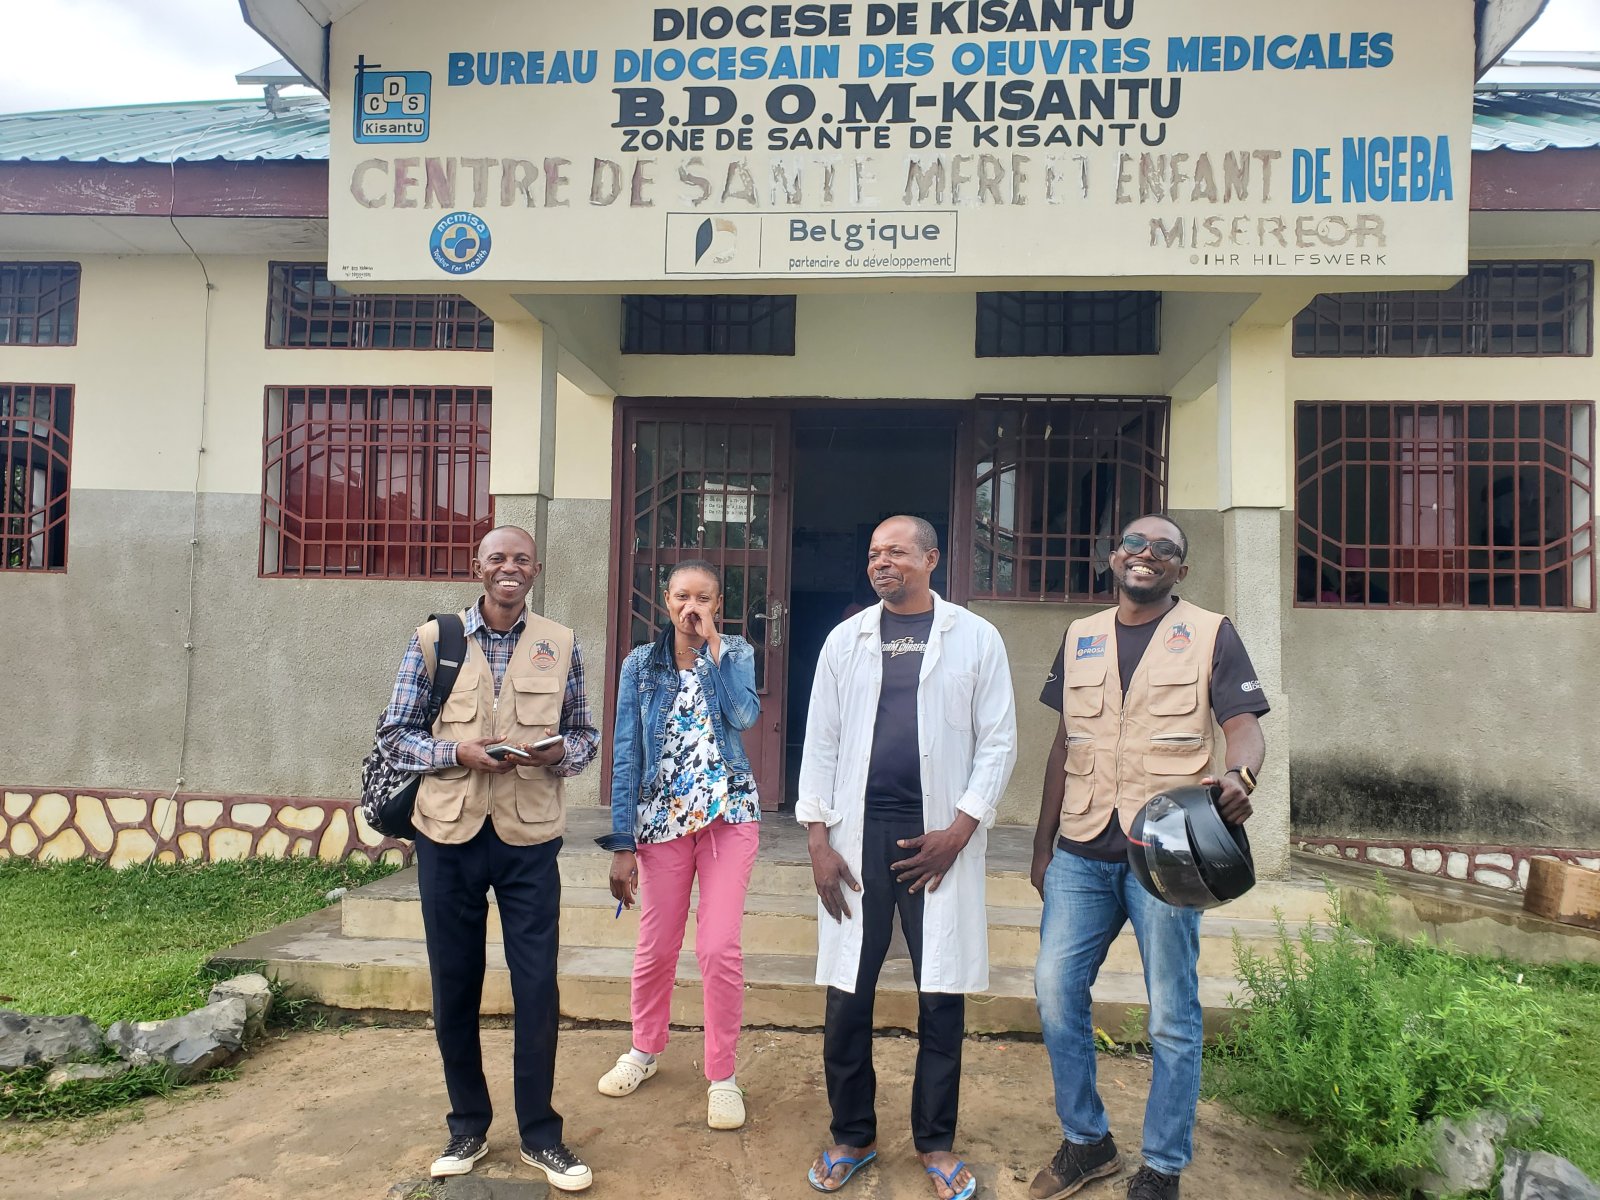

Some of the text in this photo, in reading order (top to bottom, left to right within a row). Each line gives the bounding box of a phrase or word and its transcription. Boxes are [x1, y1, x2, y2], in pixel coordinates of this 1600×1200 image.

[653, 0, 1133, 41] DIOCESE DE KISANTU
[448, 32, 1393, 86] BUREAU DIOCESAIN DES OEUVRES MEDICALES
[365, 122, 422, 133] Kisantu
[621, 123, 1166, 151] ZONE DE SANTE DE KISANTU
[350, 157, 572, 208] CENTRE
[589, 157, 656, 208] DE
[1115, 150, 1281, 204] ENFANT
[1292, 148, 1331, 203] DE
[1342, 135, 1453, 203] NGEBA
[789, 218, 940, 250] Belgique
[1150, 214, 1387, 248] MISEREOR
[789, 253, 951, 271] partenaire du développement
[1204, 254, 1240, 265] IHR
